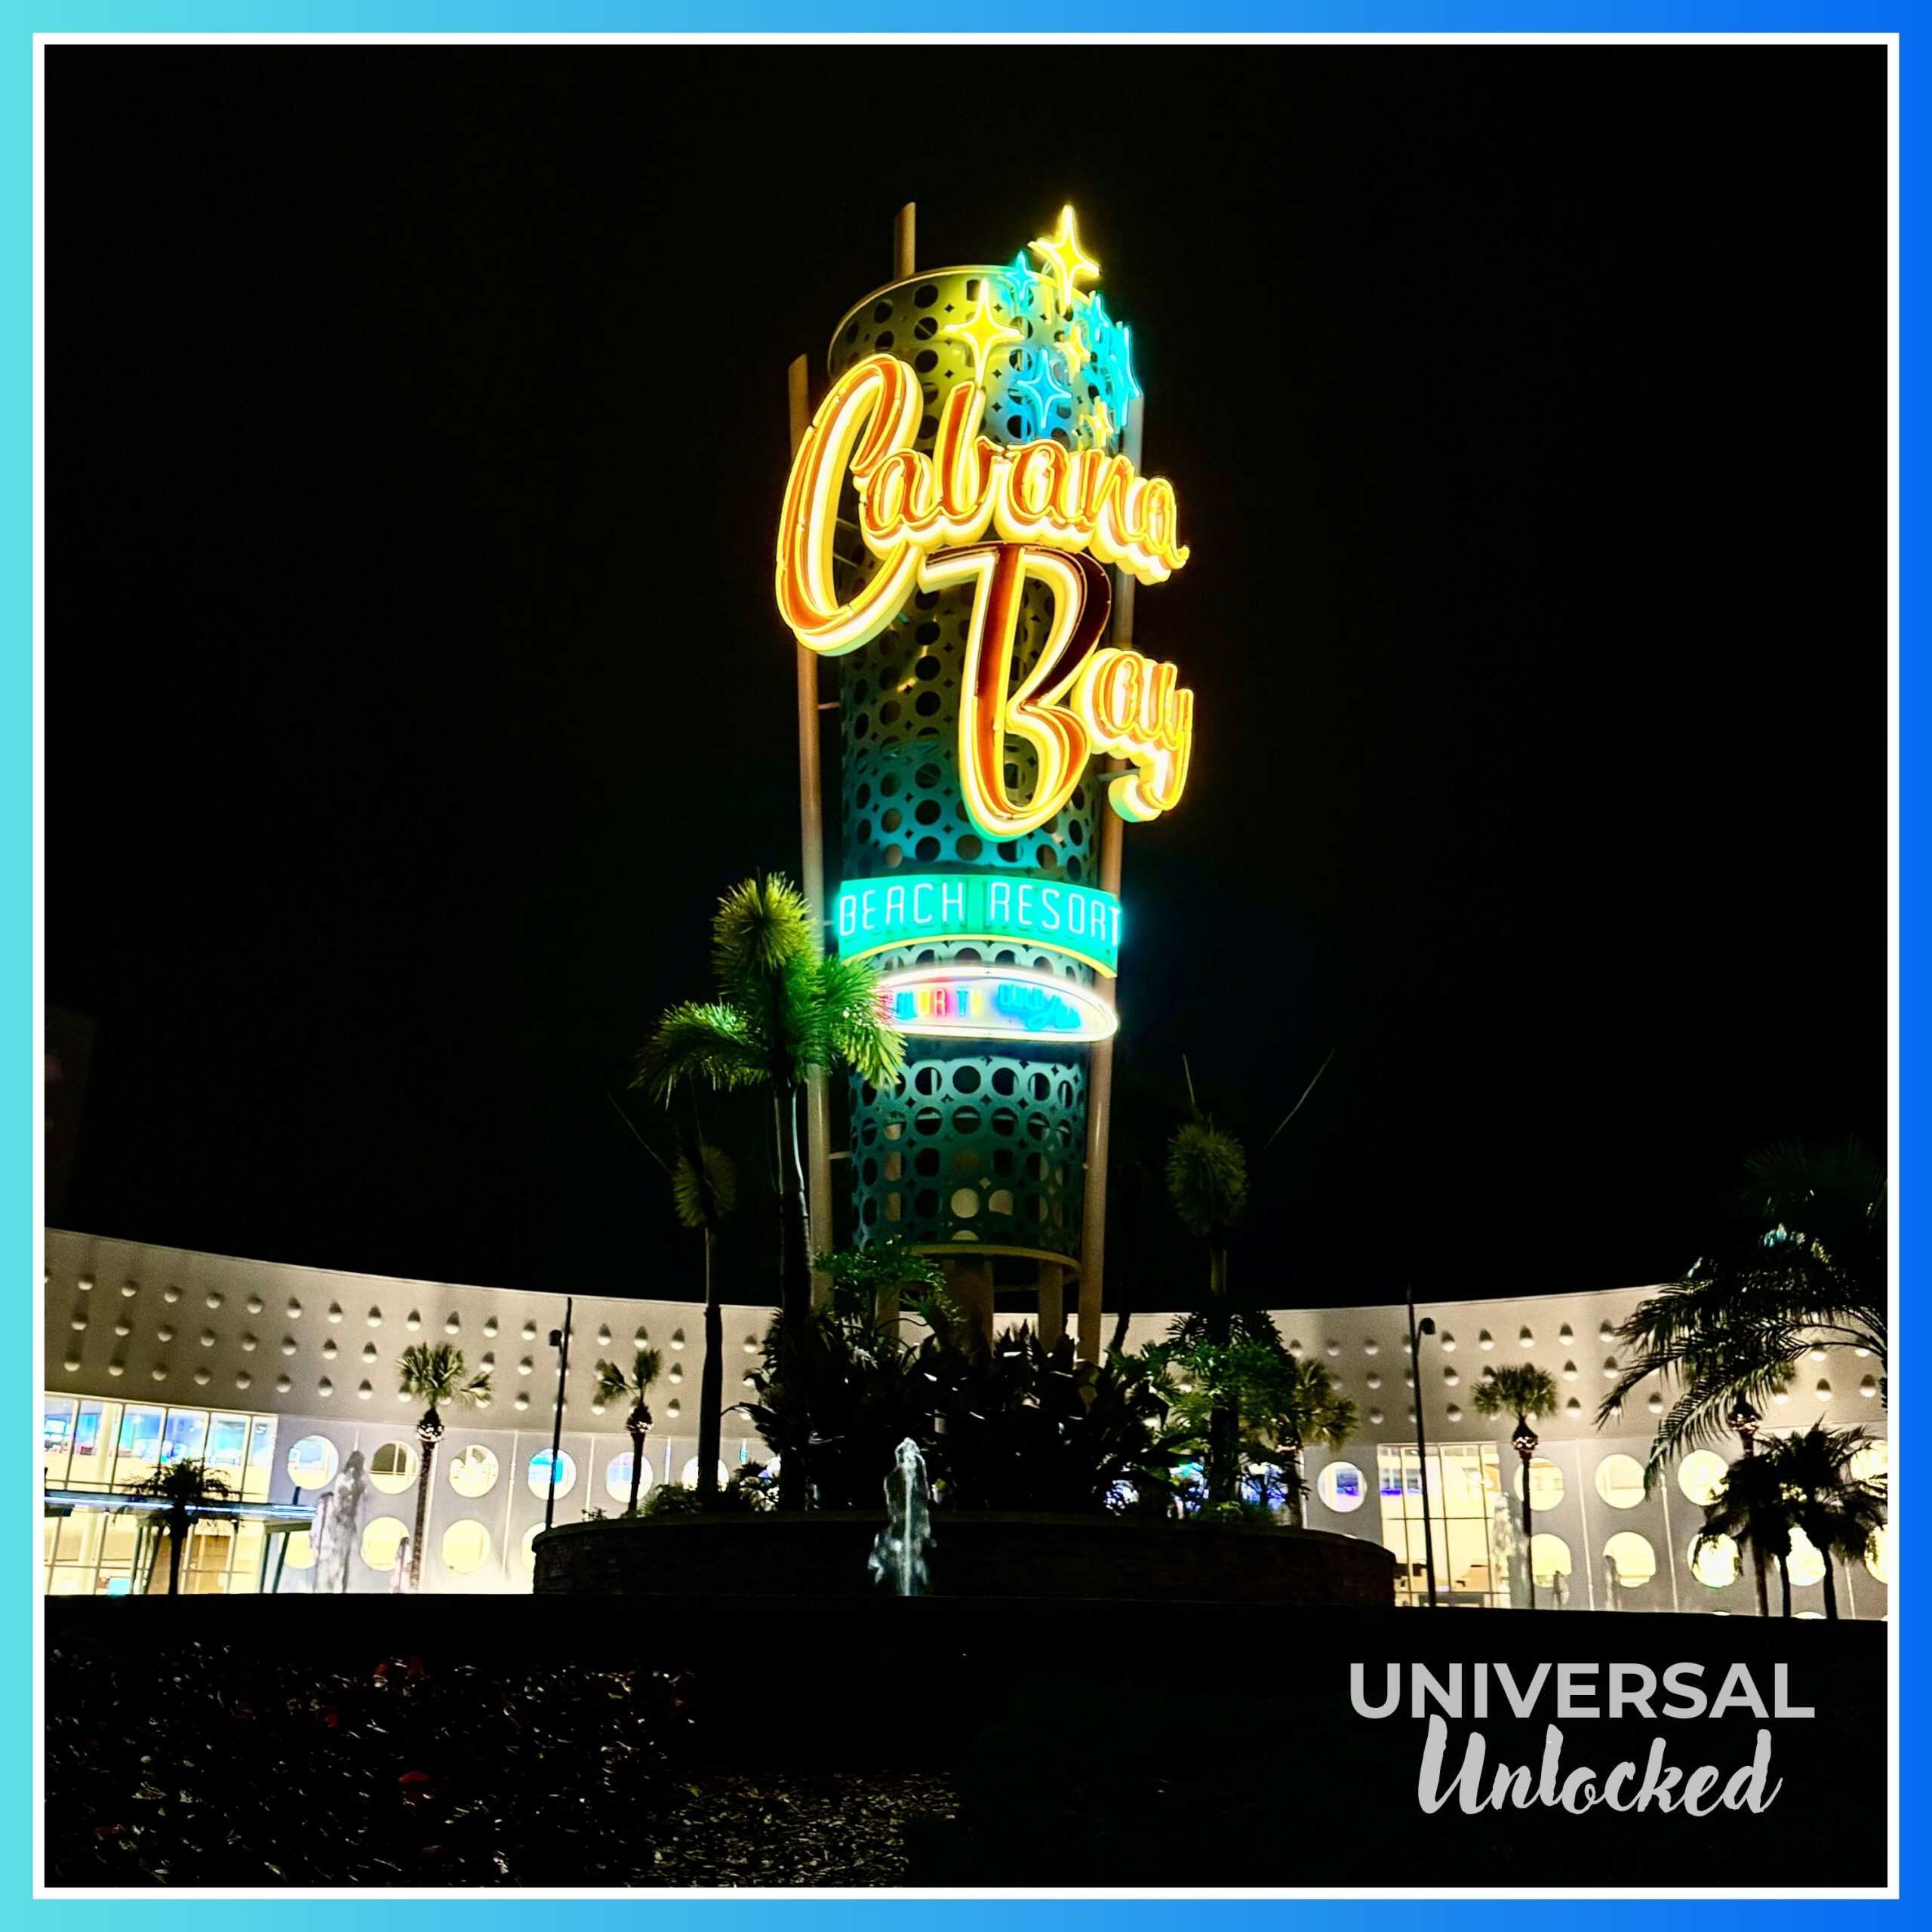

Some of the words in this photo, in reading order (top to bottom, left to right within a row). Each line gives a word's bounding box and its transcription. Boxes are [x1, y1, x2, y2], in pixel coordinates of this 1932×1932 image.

[775, 352, 1190, 657] Cabana
[918, 540, 1194, 843] Bay
[838, 881, 965, 937] BEACH
[989, 881, 1122, 946] RESORT
